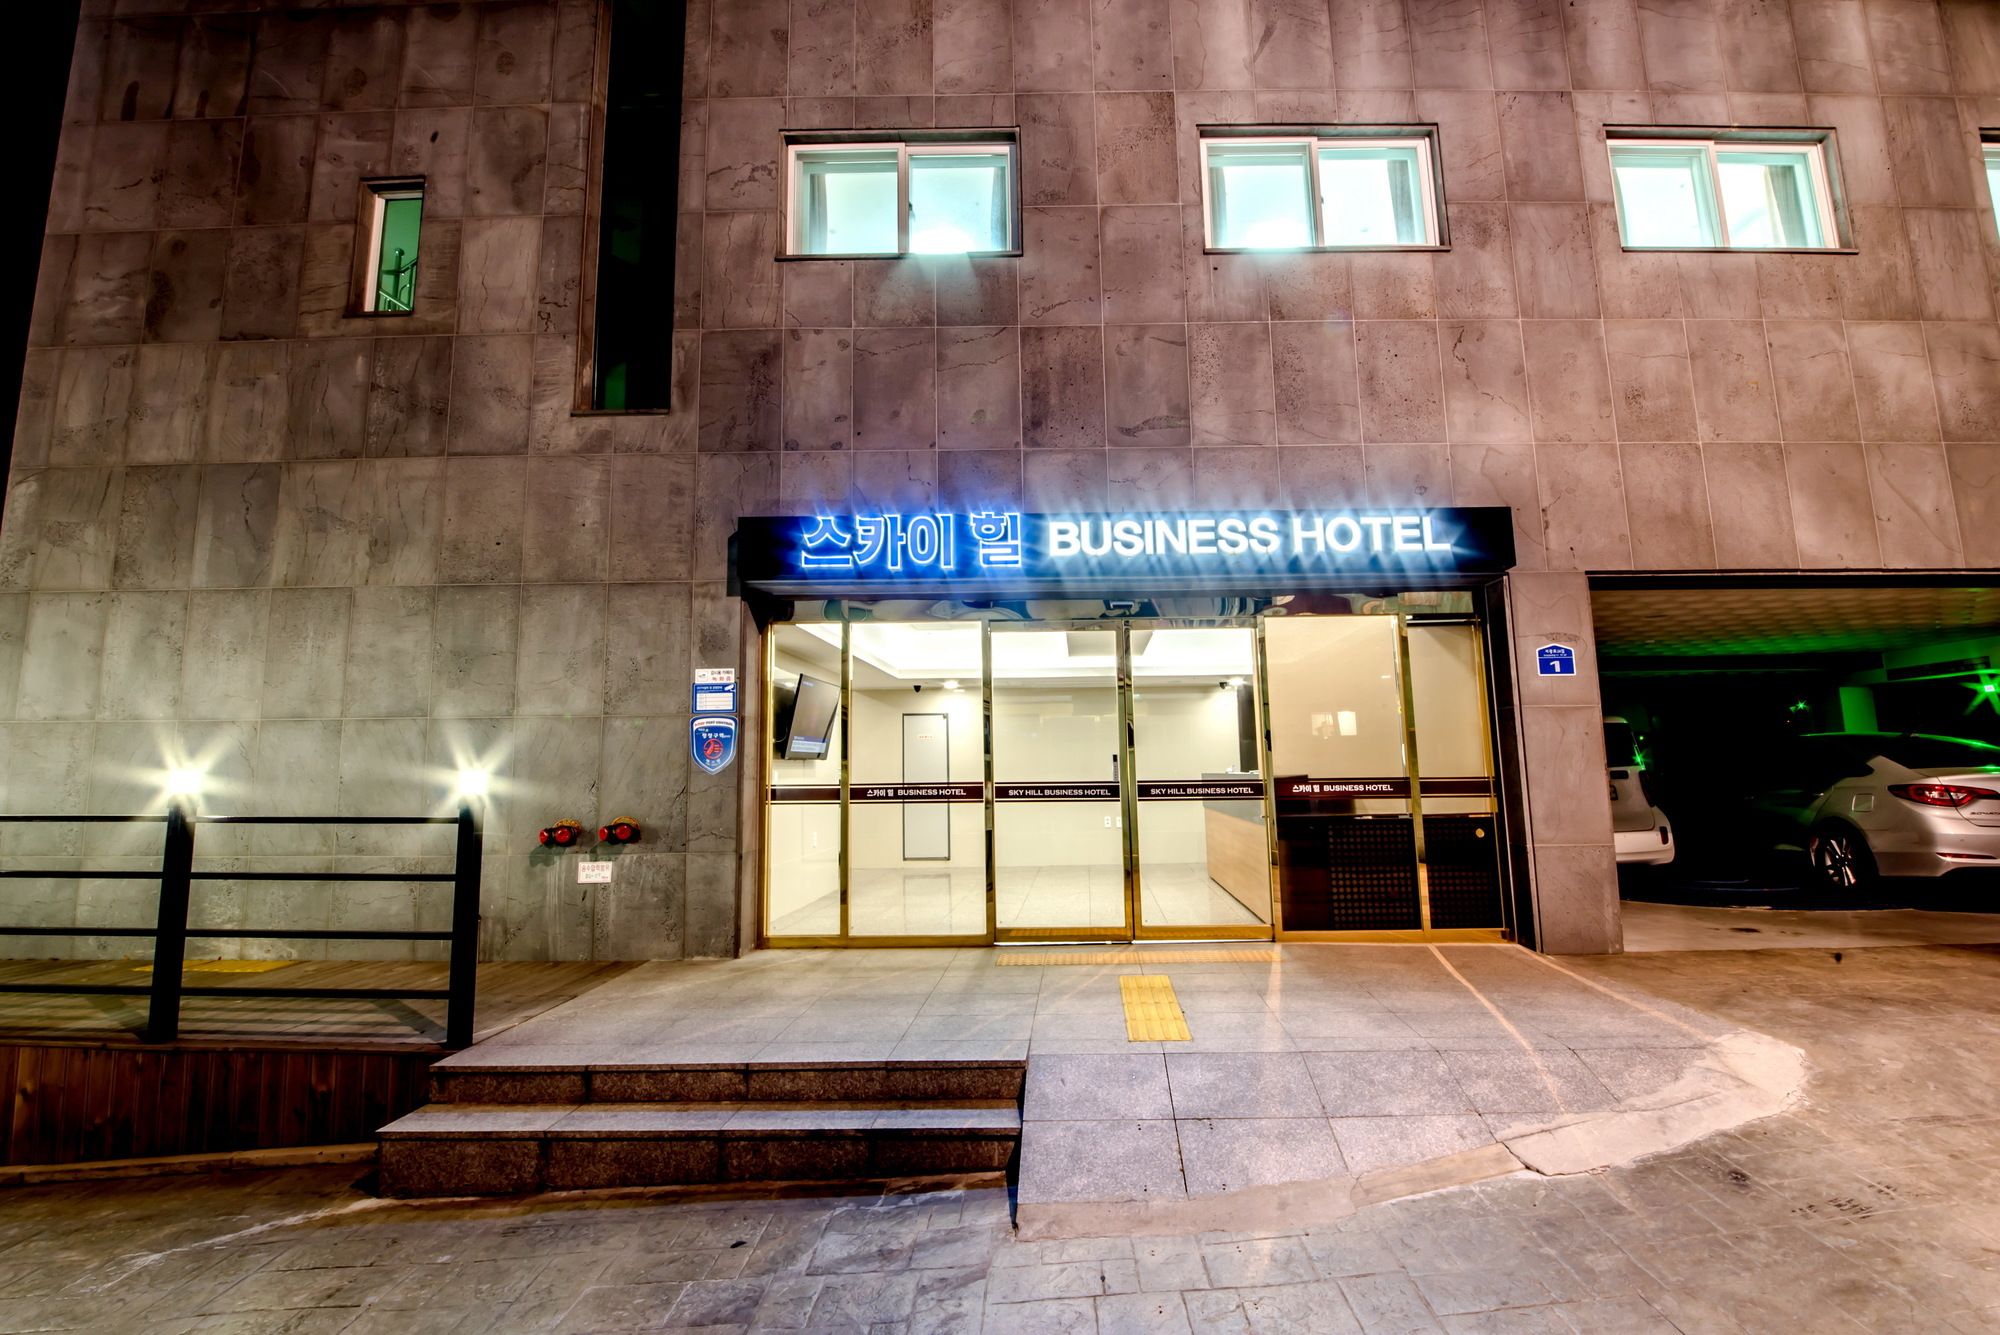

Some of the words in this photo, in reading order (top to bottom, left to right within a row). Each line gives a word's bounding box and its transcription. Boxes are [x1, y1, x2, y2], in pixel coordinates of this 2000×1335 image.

[800, 511, 953, 570] 스카이
[969, 511, 1022, 568] 힐
[1047, 516, 1280, 558] BUSINESS
[1292, 514, 1452, 554] HOTEL
[1550, 660, 1560, 672] 1
[866, 788, 886, 797] 스카이
[897, 788, 938, 796] BUSINESS
[938, 788, 967, 796] HOTEL
[1008, 789, 1024, 797] SKY
[1025, 789, 1044, 797] HILL
[1084, 788, 1111, 796] HOTEL
[1186, 787, 1226, 795] BUSINESS
[1292, 784, 1312, 793] 스카이
[1323, 784, 1364, 792] BUSINESS
[1365, 784, 1393, 792] HOTEL
